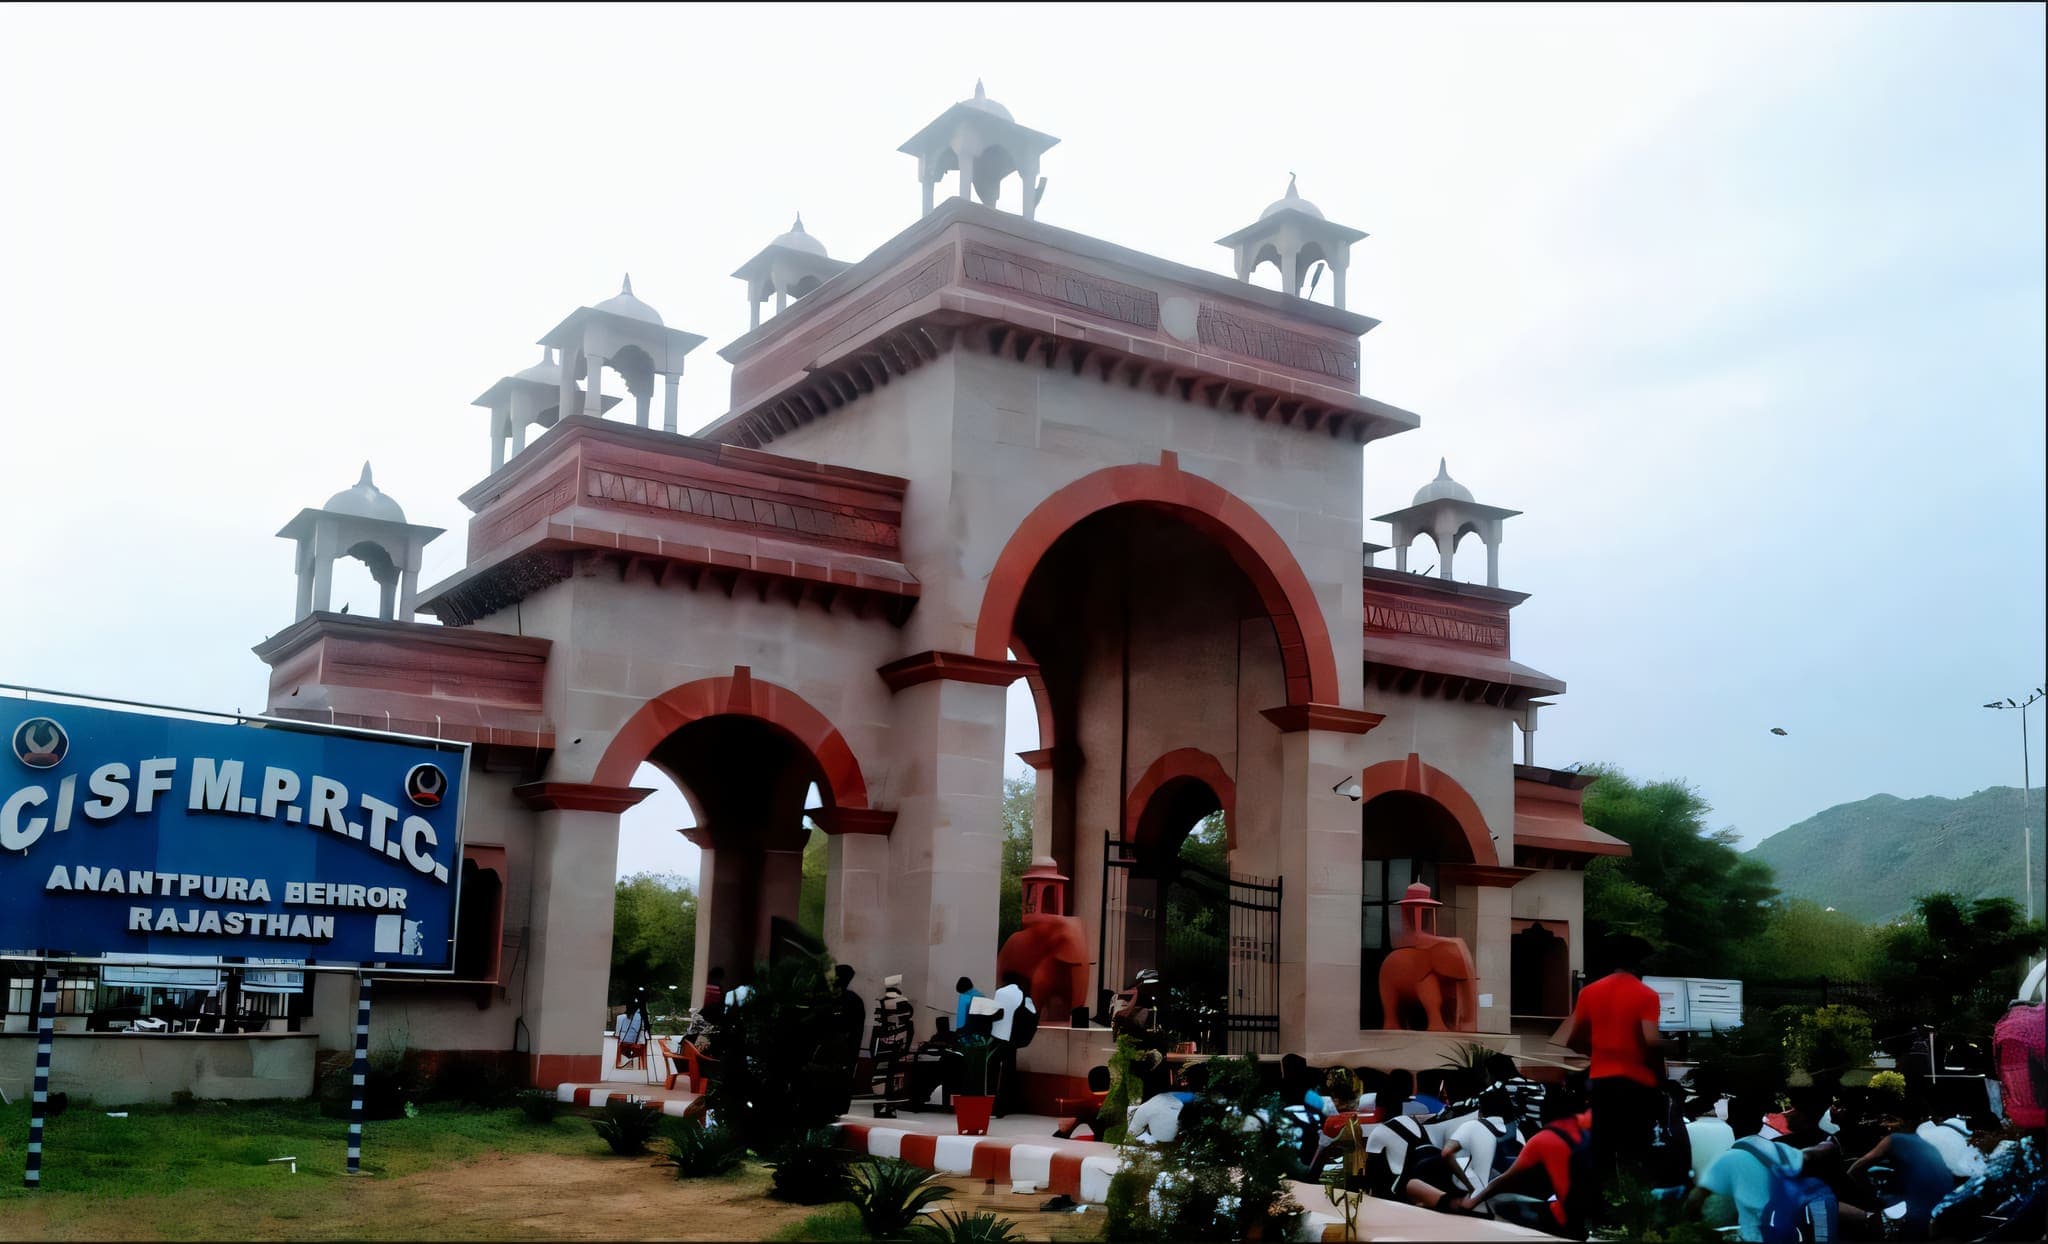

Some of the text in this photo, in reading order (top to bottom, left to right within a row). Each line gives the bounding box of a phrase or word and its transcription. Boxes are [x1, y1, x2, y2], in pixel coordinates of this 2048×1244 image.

[0, 757, 449, 884] CISF M.P.R.T.C.
[45, 864, 408, 910] ANANTPURA BEHROR
[128, 906, 335, 939] RAJASTHAN
